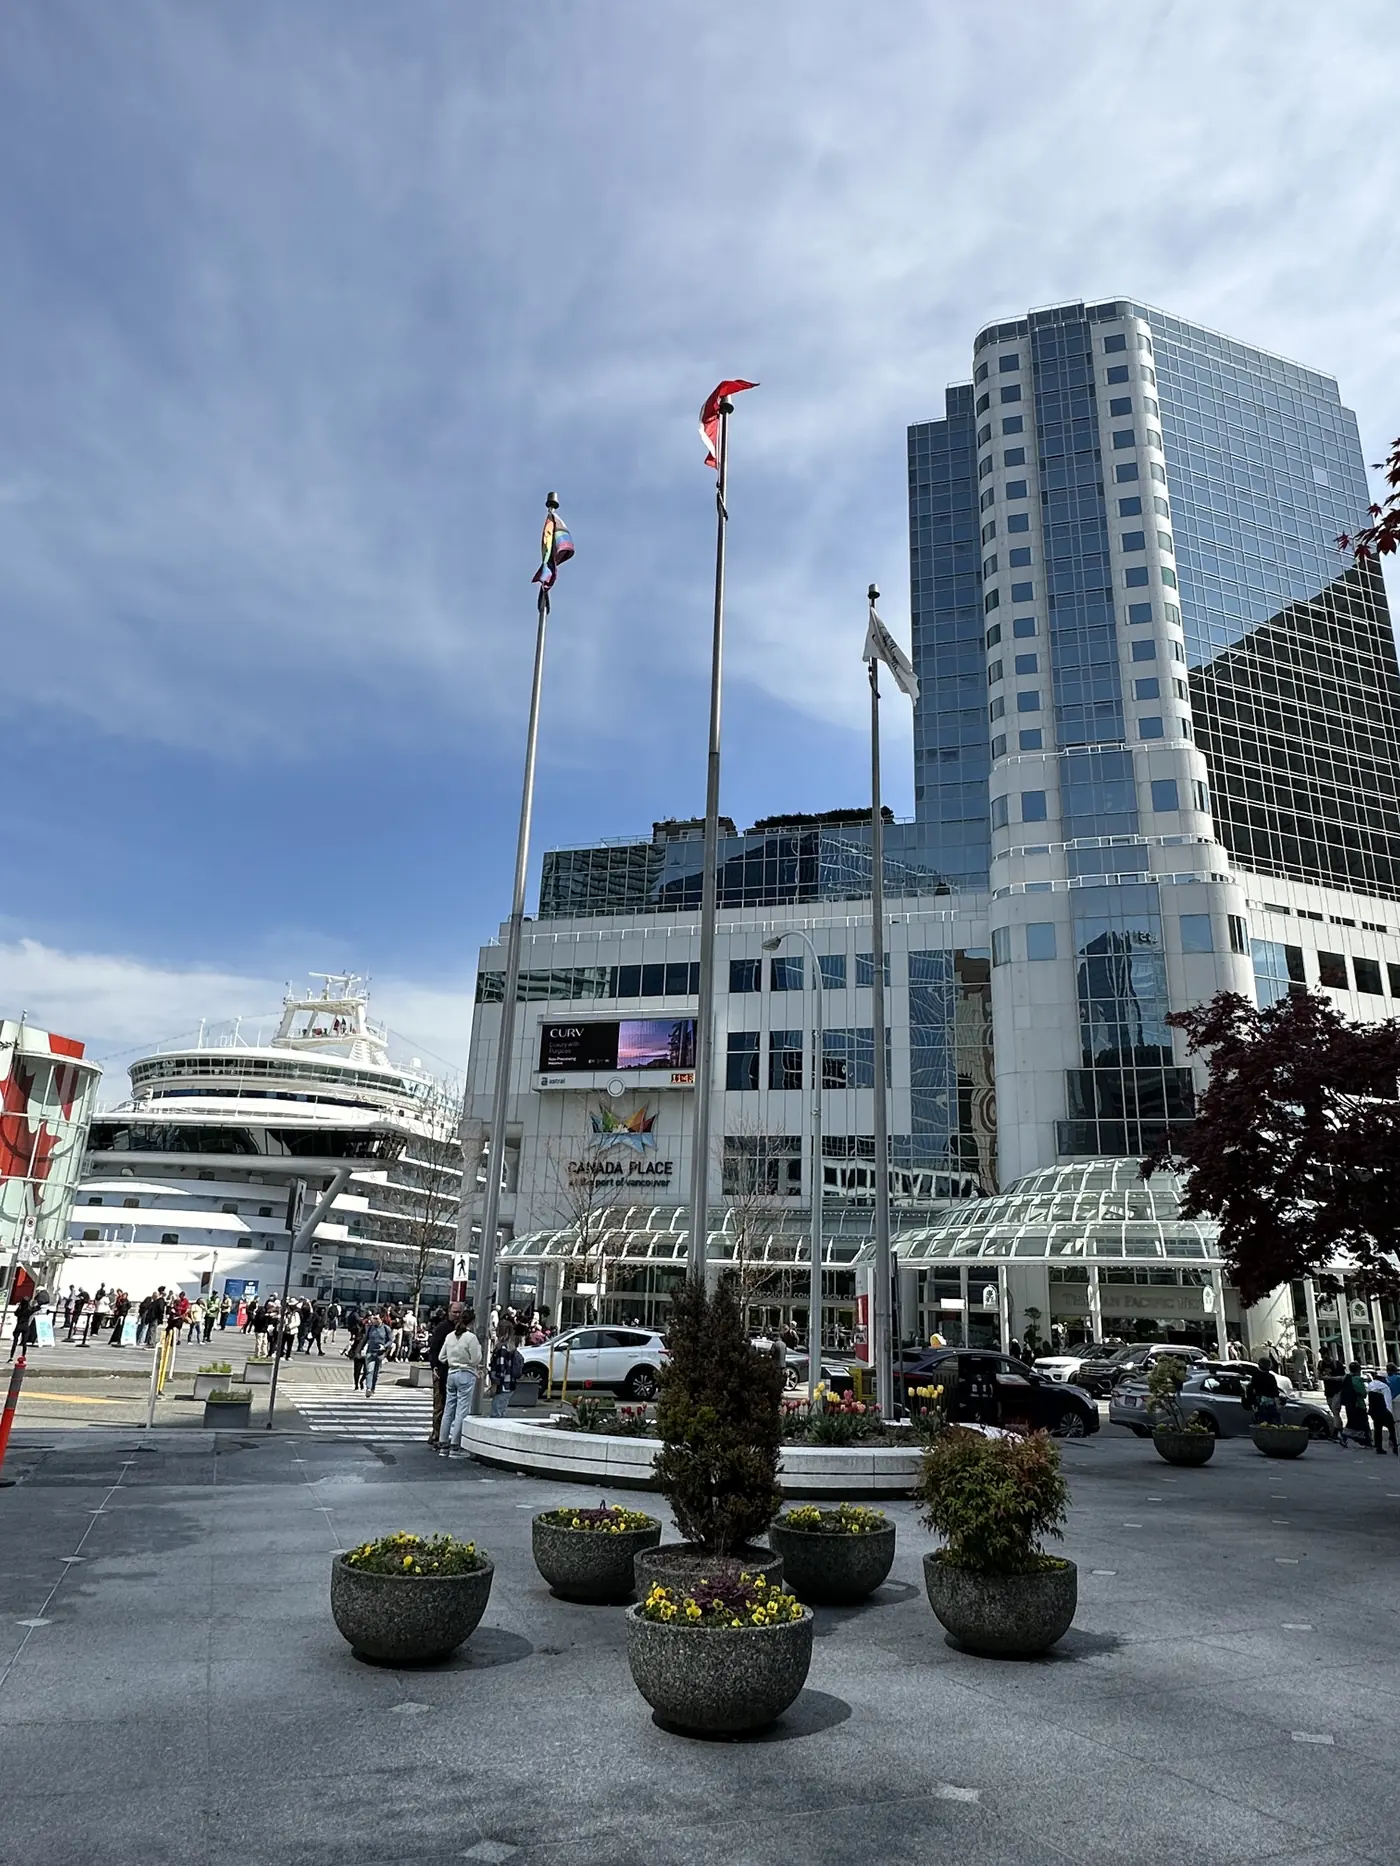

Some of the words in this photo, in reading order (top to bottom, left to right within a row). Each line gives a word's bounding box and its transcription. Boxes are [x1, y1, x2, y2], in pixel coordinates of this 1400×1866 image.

[550, 1028, 584, 1038] CURV
[568, 1161, 623, 1174] CANADA
[629, 1161, 673, 1175] PLACE
[595, 1178, 614, 1188] port
